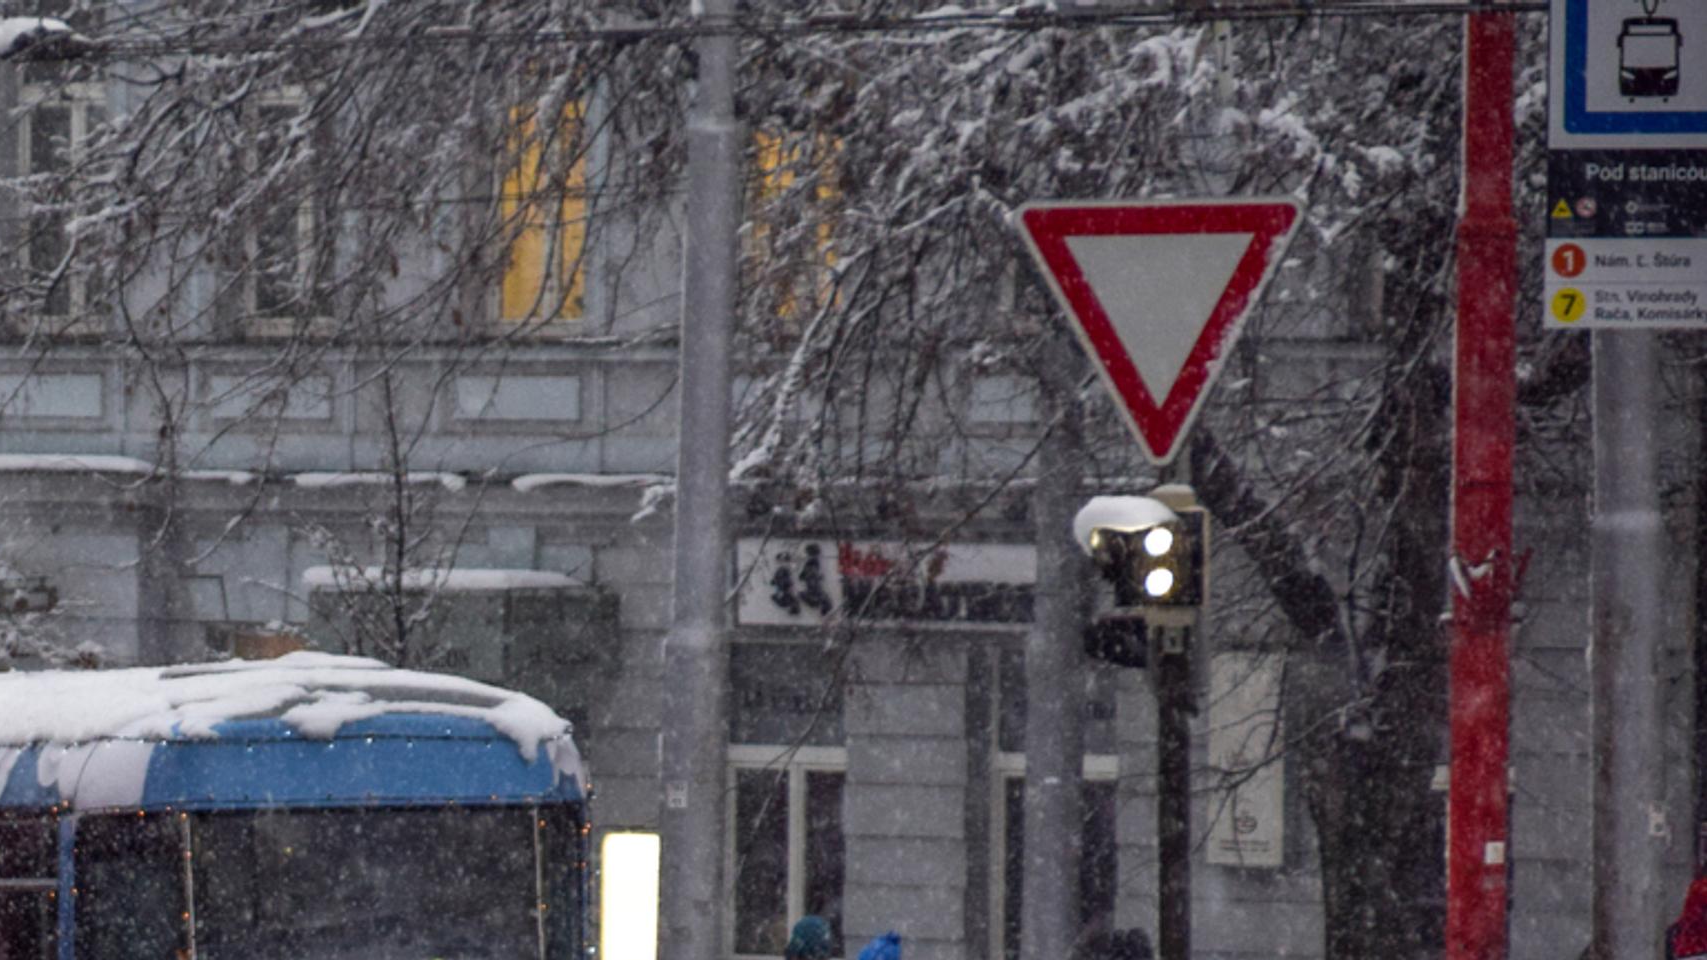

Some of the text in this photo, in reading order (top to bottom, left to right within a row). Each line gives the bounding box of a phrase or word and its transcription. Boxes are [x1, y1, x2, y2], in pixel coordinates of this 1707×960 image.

[1585, 163, 1707, 181] Pod stanicou
[1562, 250, 1575, 273] 1
[1560, 294, 1577, 316] 7
[1626, 289, 1697, 306] Vinohrady
